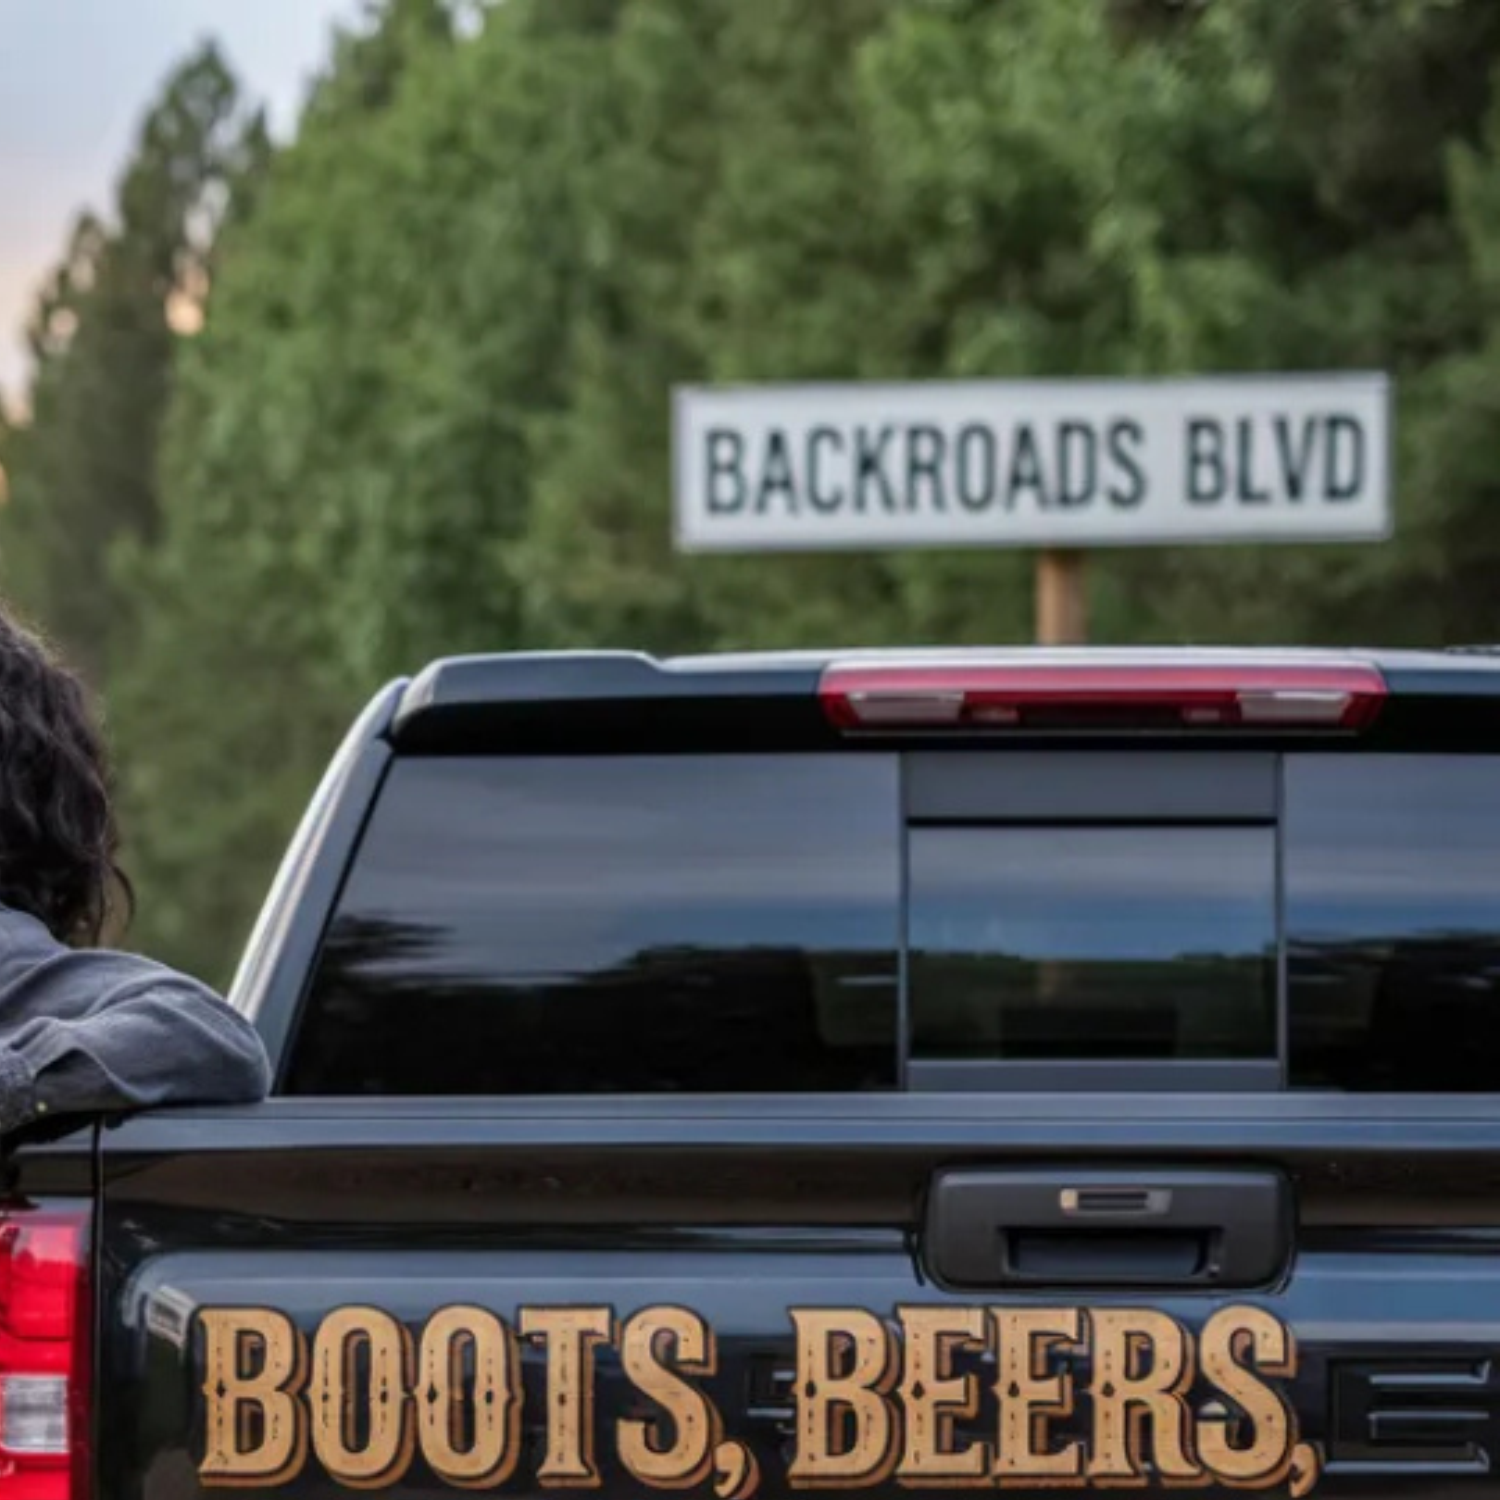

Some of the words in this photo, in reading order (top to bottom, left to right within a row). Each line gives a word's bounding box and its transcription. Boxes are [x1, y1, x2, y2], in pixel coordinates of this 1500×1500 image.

[704, 416, 1147, 516] BACKROADS
[1184, 414, 1366, 503] BLVD
[198, 1304, 760, 1500] BOOTS,
[787, 1303, 1325, 1499] BEERS,
